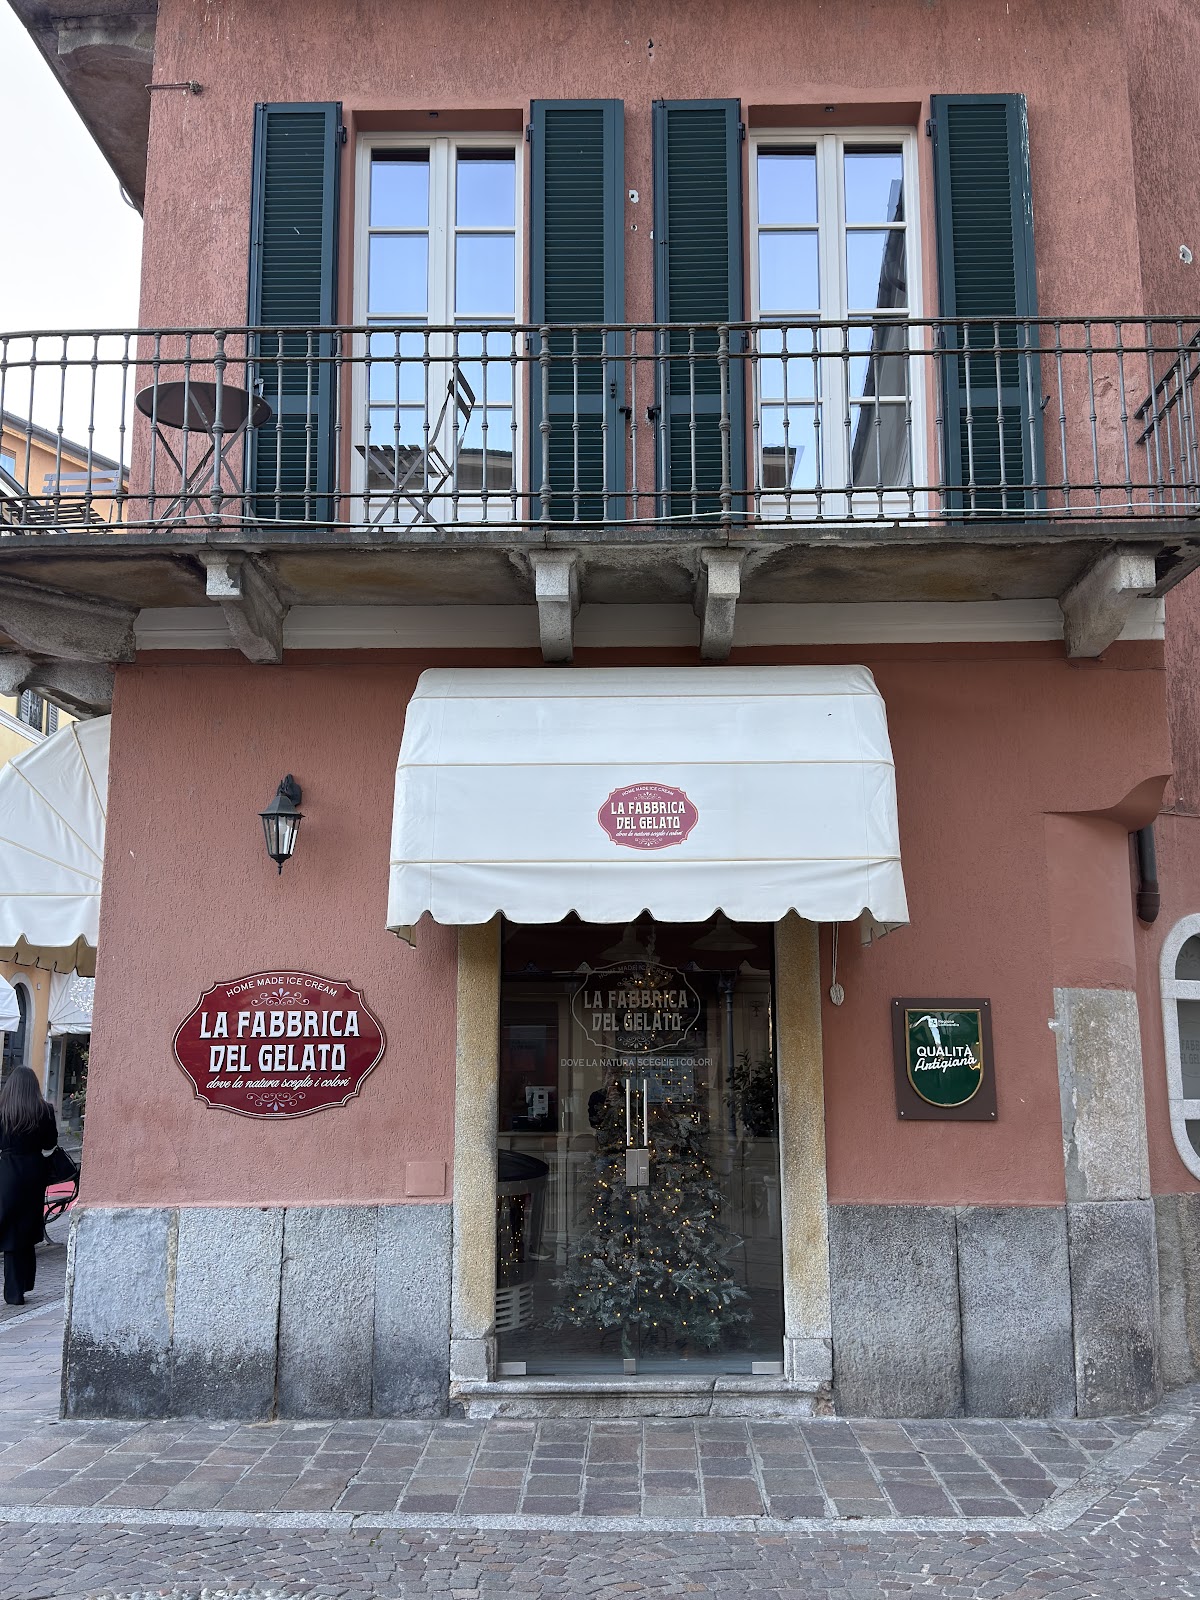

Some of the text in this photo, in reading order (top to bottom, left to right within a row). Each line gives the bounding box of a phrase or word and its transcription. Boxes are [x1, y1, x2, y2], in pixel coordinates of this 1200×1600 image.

[611, 801, 686, 815] LA FABBRICA
[616, 816, 680, 830] DEL GELATO
[226, 977, 338, 997] HOME MADE ICE CREAM
[584, 989, 688, 1009] LA FABBRICA
[199, 1010, 361, 1039] LA FABBRICA
[592, 1012, 682, 1031] DEL GELATO
[208, 1043, 346, 1073] DEL GELATO
[916, 1044, 973, 1057] QUALITÀ
[560, 1058, 584, 1067] DOVE
[586, 1058, 598, 1067] LA
[600, 1058, 635, 1067] NATURA
[637, 1058, 675, 1067] SCEGLIE
[680, 1058, 713, 1066] COLORI
[914, 1056, 977, 1073] Artigiana
[206, 1074, 351, 1091] dove la natura sceglie i colori
